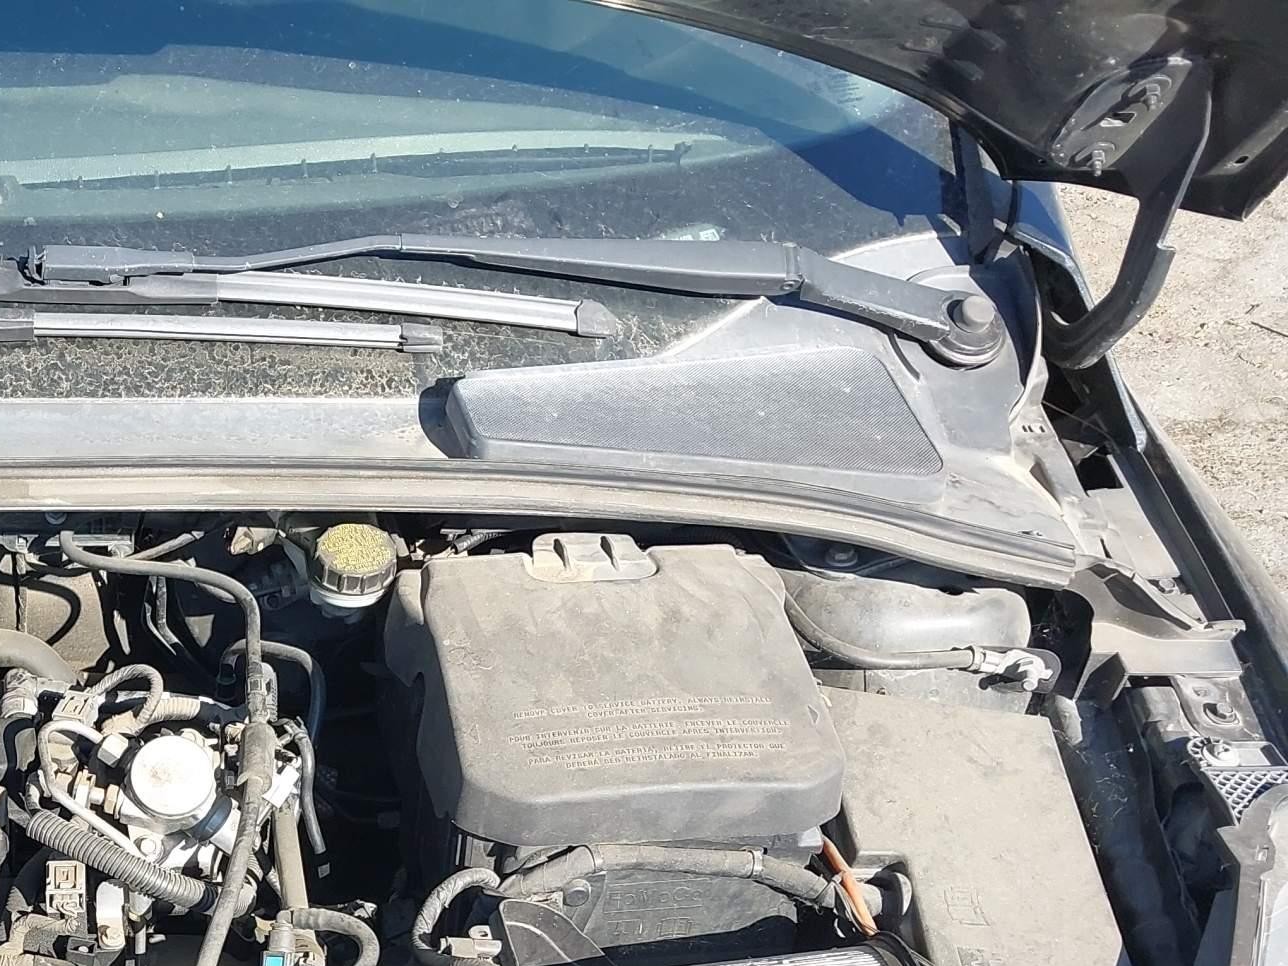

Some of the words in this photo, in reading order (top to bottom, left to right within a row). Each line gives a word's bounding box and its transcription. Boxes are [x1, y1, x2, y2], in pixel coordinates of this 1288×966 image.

[513, 709, 546, 719] REMOVE
[550, 706, 578, 715] COVER
[583, 704, 593, 712] TO
[599, 701, 636, 710] SERVICE
[688, 696, 720, 704] ALWAYS
[587, 710, 614, 719] COVER
[619, 708, 647, 716] AFTER
[509, 735, 531, 743] POUR
[535, 728, 590, 740] INTERVENIR
[595, 725, 611, 733] SUR
[615, 724, 627, 732] LA
[522, 739, 565, 749] TOUJOURS
[570, 735, 608, 744] REPOSER
[614, 732, 624, 740] LE
[529, 756, 551, 766] PARA
[555, 752, 594, 761] REVISAR
[701, 743, 710, 751] EL
[769, 742, 785, 750] QUE
[604, 756, 621, 765] SER
[625, 753, 685, 762] REINSTALADO
[690, 752, 702, 760] AL
